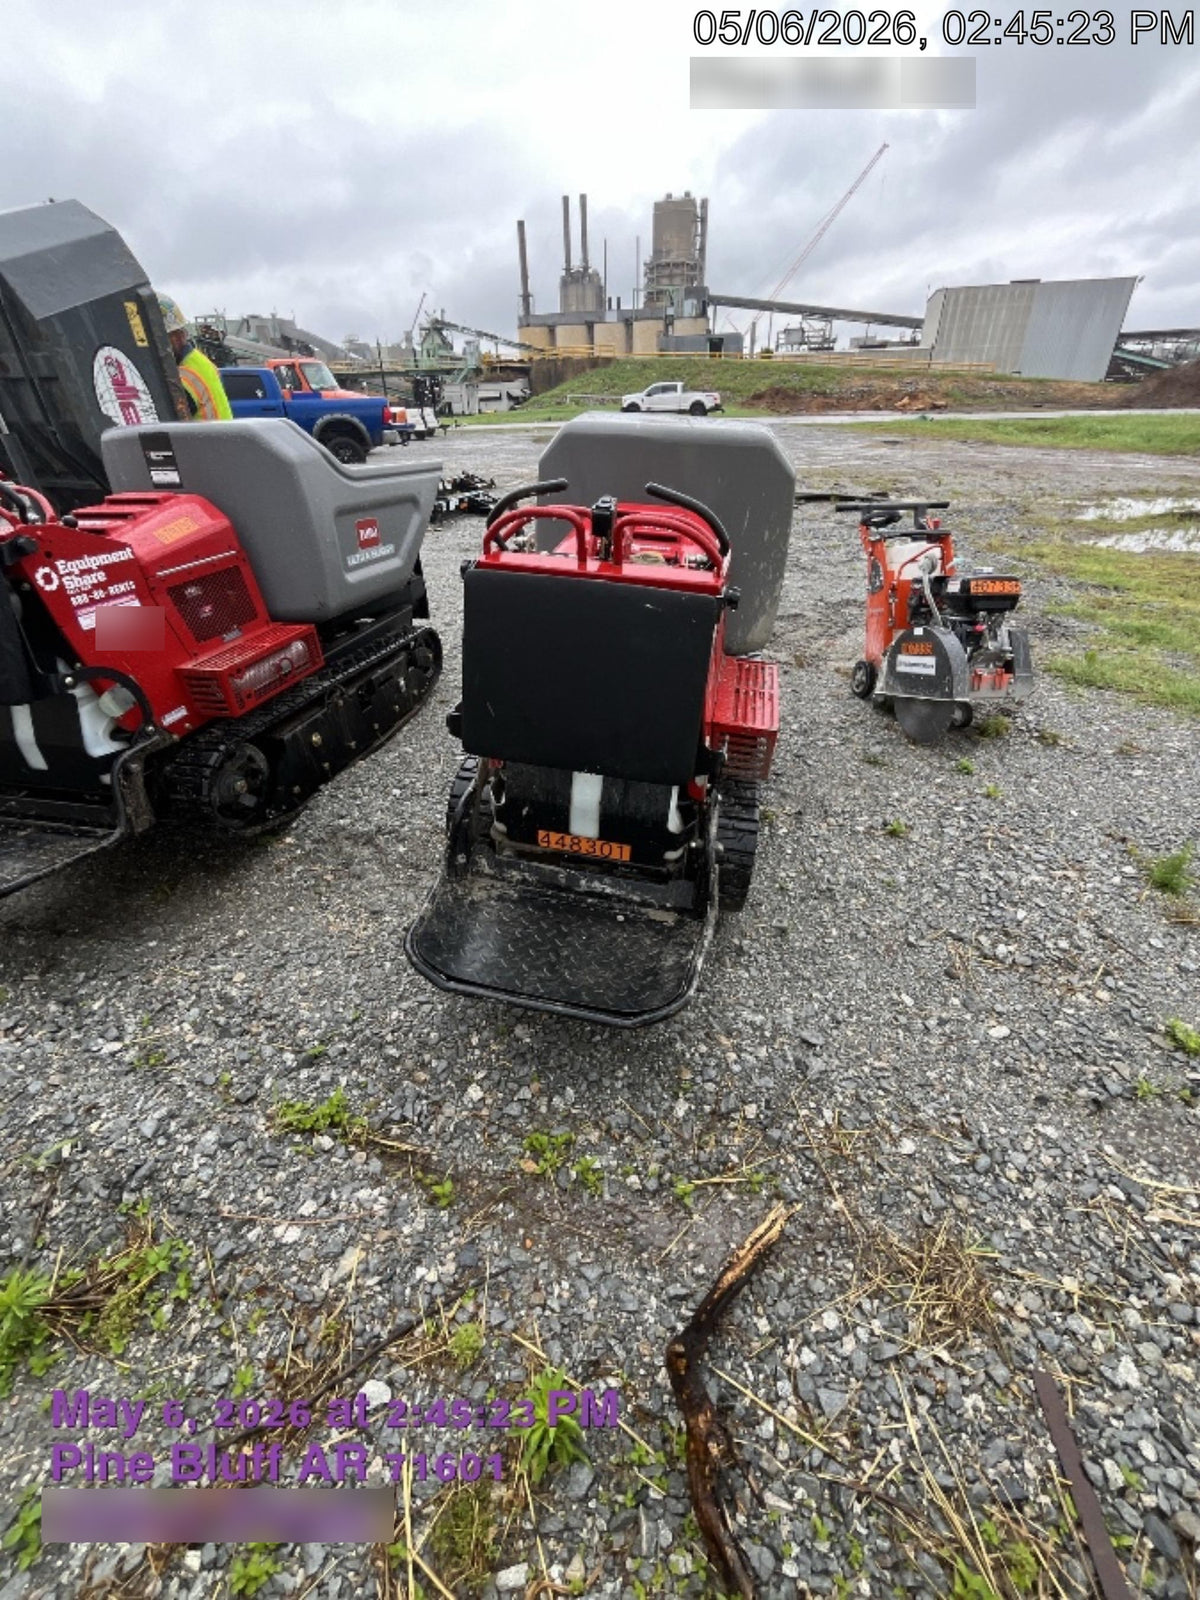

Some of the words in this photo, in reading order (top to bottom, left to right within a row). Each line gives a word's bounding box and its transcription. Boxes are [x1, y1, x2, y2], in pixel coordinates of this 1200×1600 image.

[104, 356, 141, 425] alle
[55, 547, 134, 574] Equipment
[61, 571, 107, 590] Share
[540, 833, 625, 860] 448301
